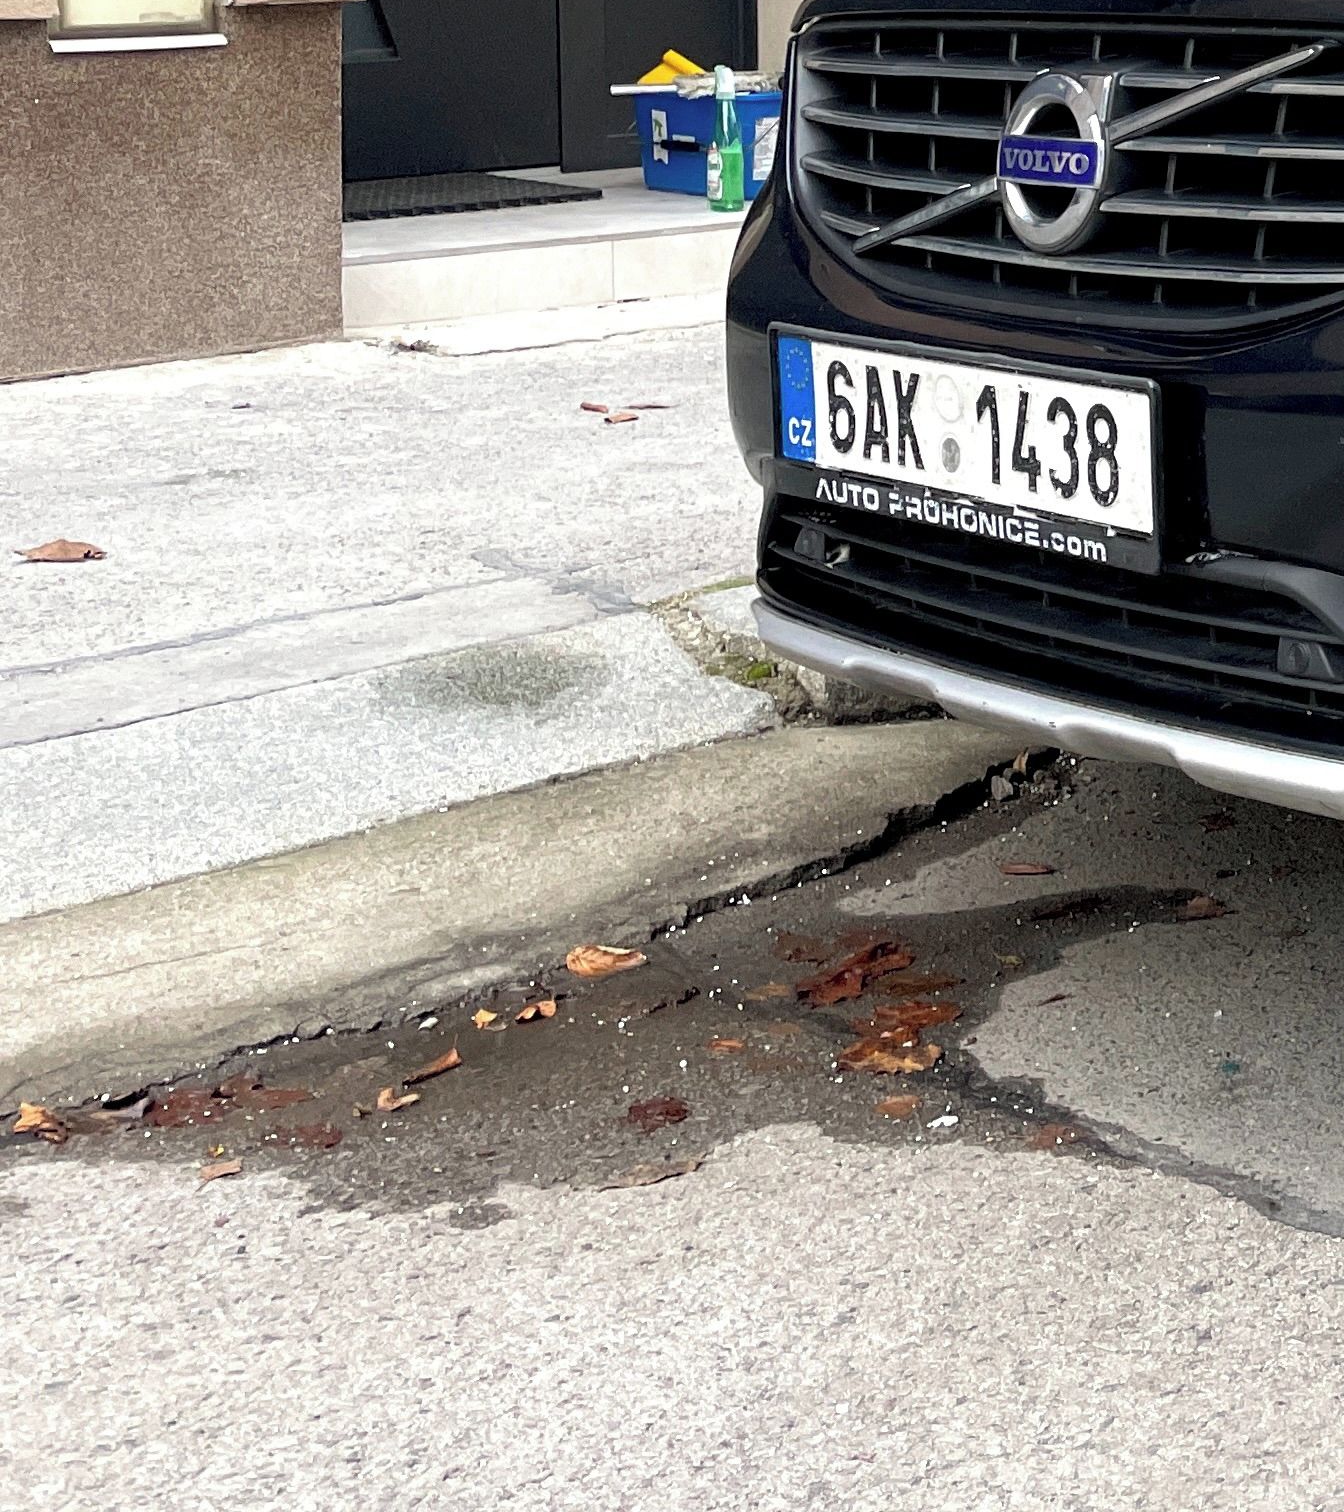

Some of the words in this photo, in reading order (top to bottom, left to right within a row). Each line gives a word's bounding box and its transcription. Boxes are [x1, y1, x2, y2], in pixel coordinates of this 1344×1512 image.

[1003, 147, 1090, 175] VOLVO
[788, 417, 814, 448] CZ
[826, 360, 925, 471] 6AK
[975, 384, 1119, 508] 1438
[815, 477, 881, 512] AUTO
